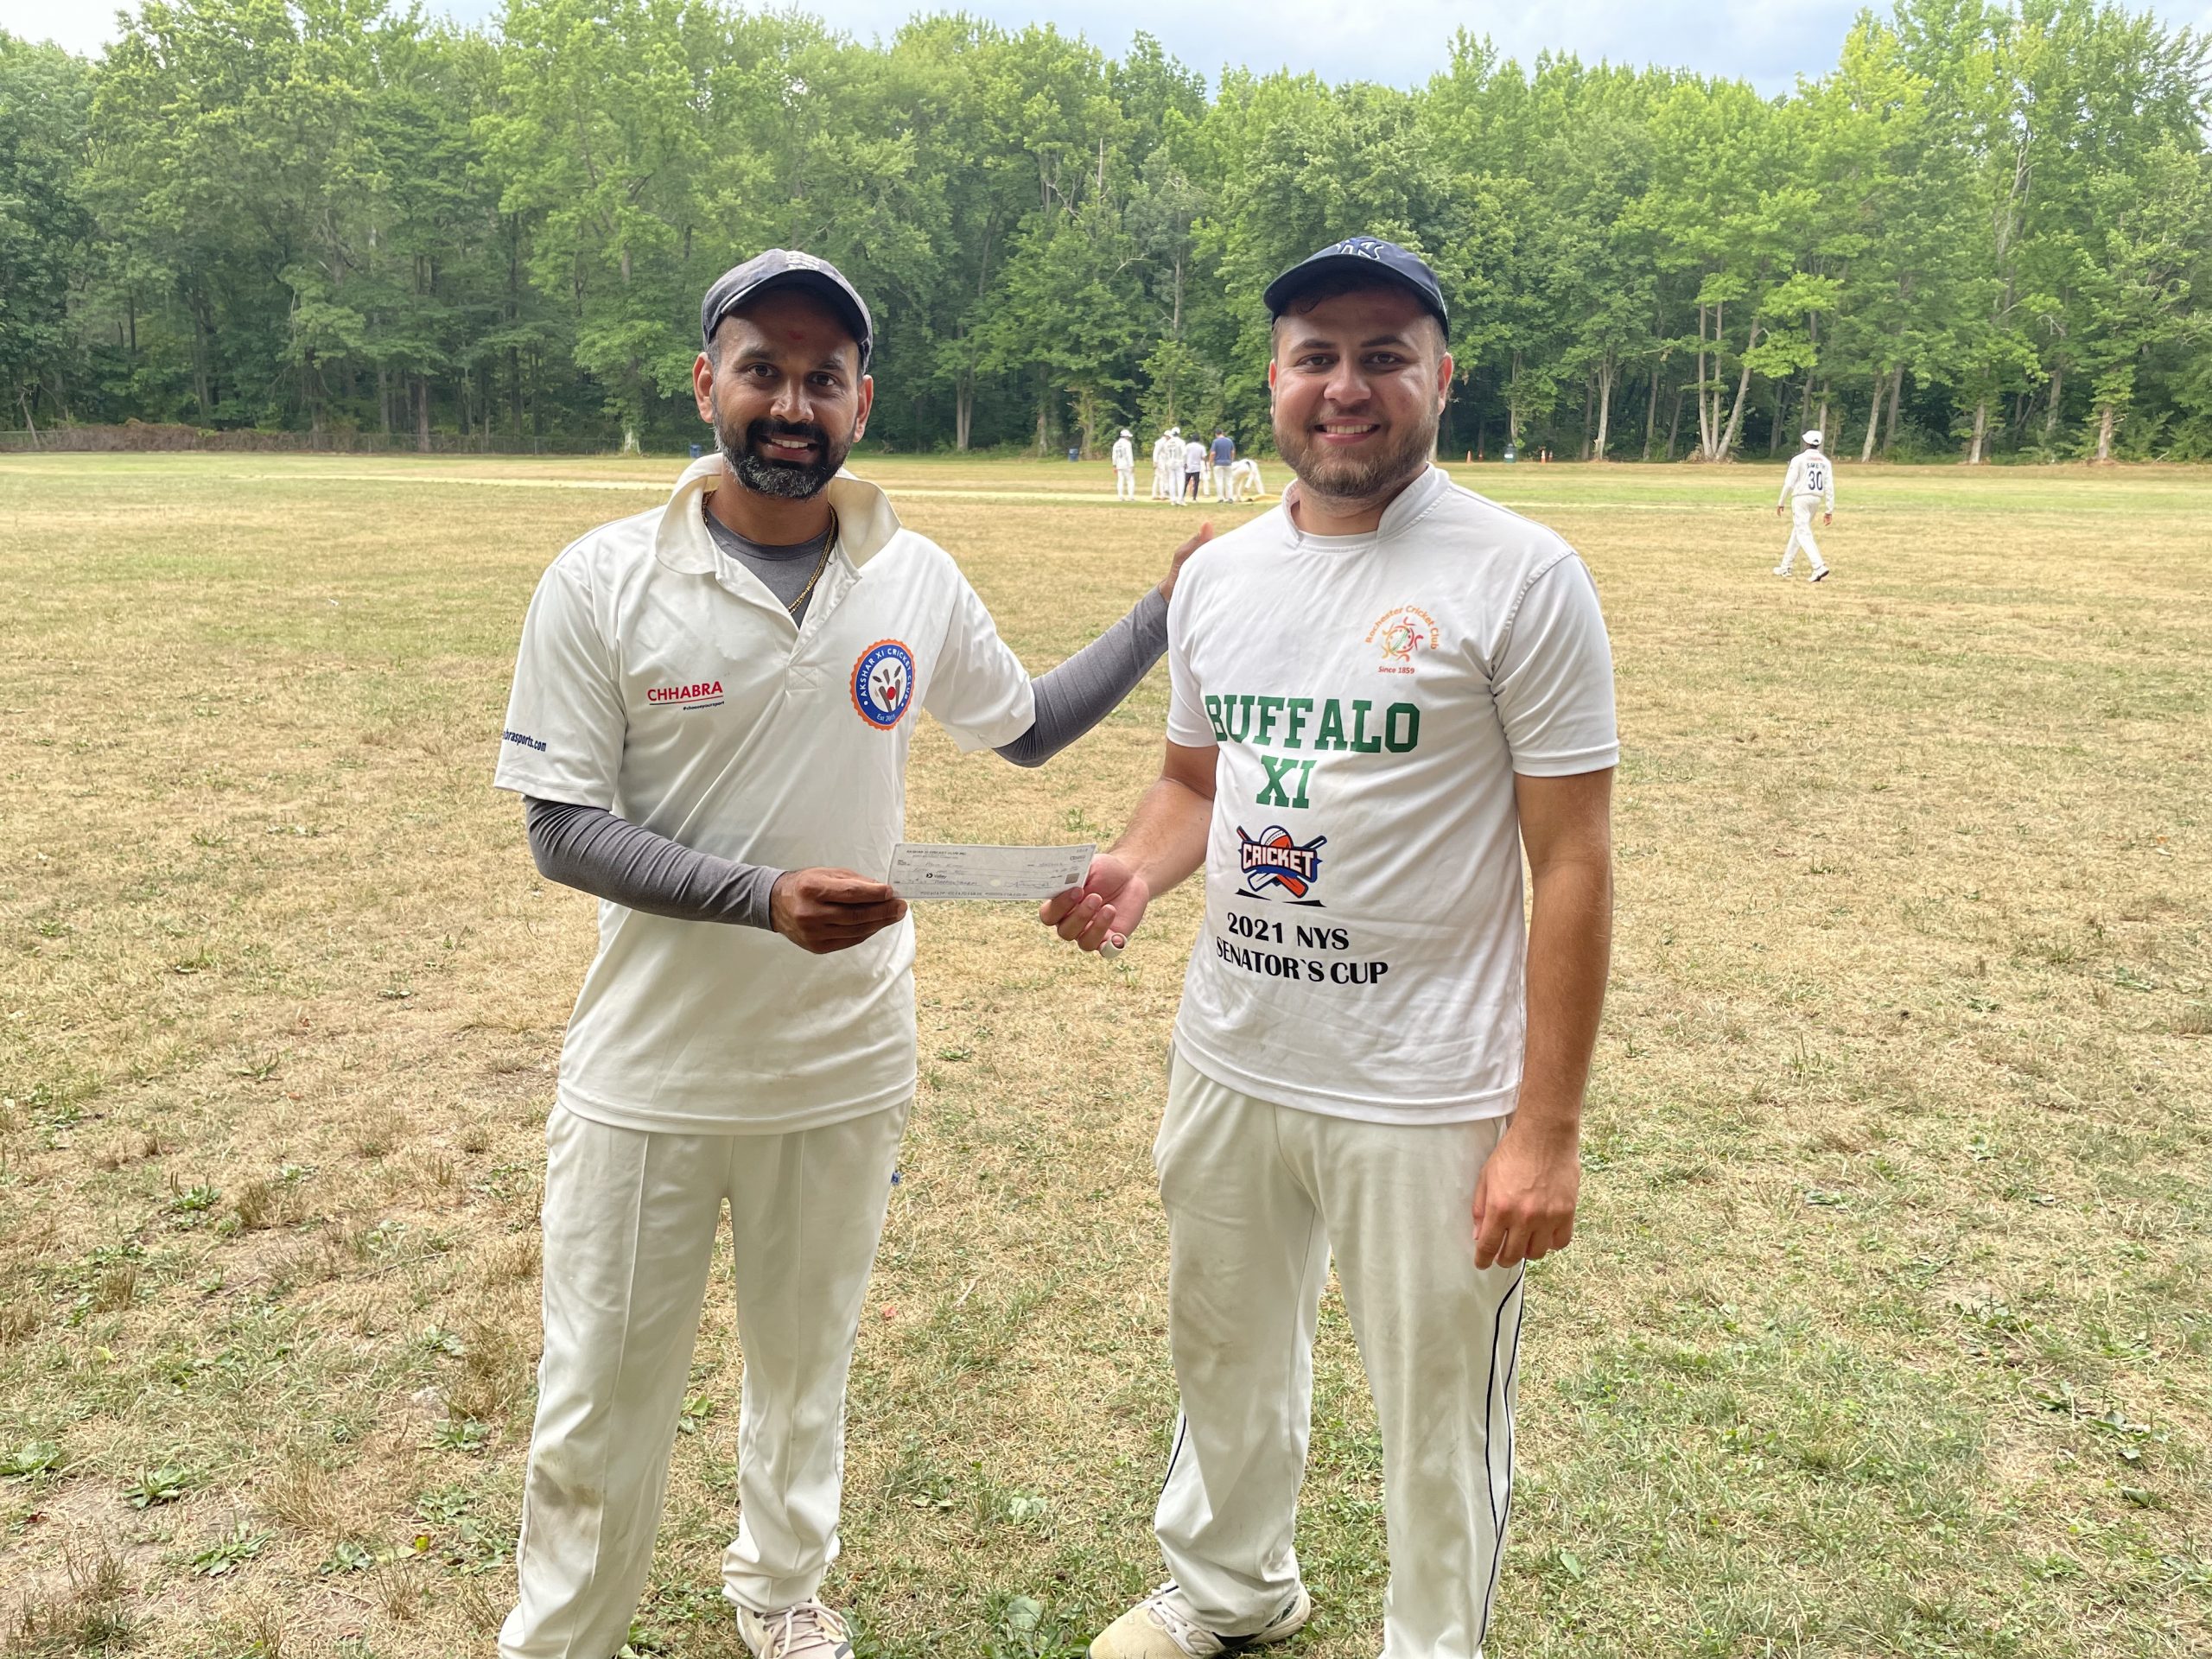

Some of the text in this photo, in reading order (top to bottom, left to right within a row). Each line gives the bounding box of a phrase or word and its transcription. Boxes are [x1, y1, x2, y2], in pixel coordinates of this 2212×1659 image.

[1808, 470, 1823, 491] 30
[1365, 605, 1439, 650] Rochester Cricket Club
[860, 658, 875, 696] AKSHAR
[875, 650, 885, 659] XI
[887, 648, 912, 671] CRICKET
[647, 681, 723, 702] CHHABRA
[1205, 694, 1421, 753] BUFFALO
[1255, 754, 1317, 809] XI
[1243, 842, 1314, 879] CRICKET
[1227, 912, 1349, 950] 2021 NYS
[1330, 961, 1389, 984] CUP
